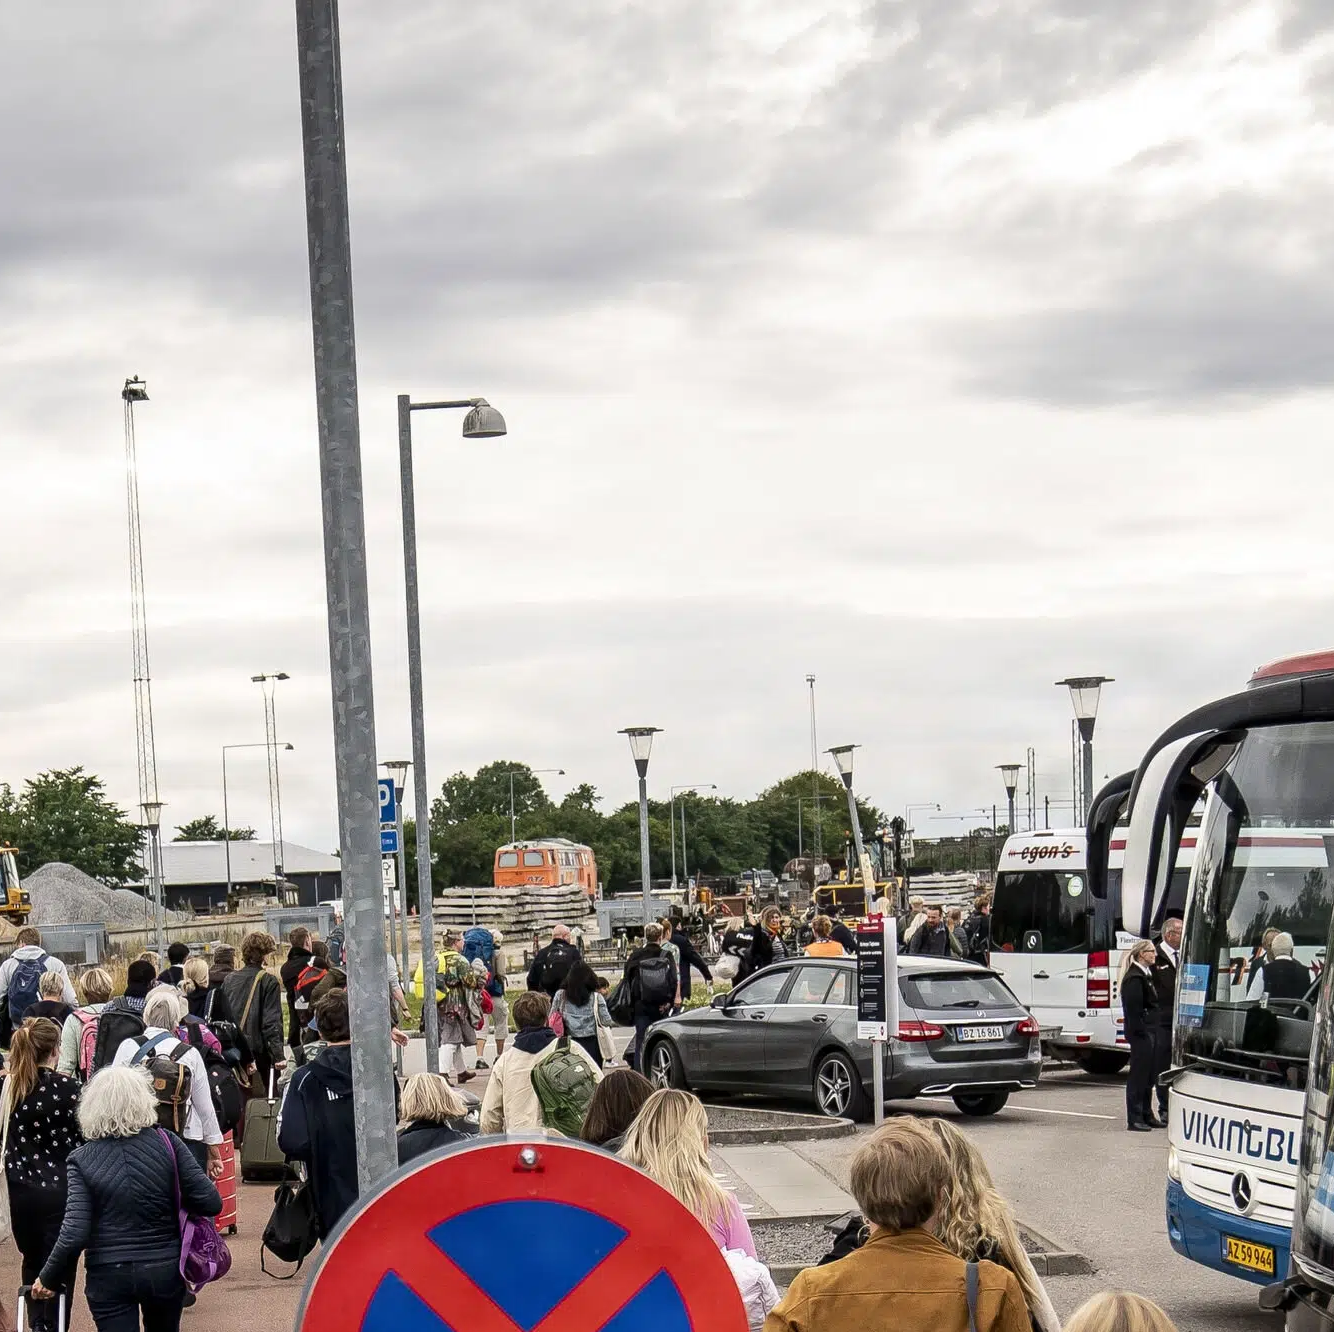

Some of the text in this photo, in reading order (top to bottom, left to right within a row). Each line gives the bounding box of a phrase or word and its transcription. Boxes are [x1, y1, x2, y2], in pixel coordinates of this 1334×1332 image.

[1021, 842, 1073, 864] egon's
[1228, 1241, 1273, 1269] AZ 59 944
